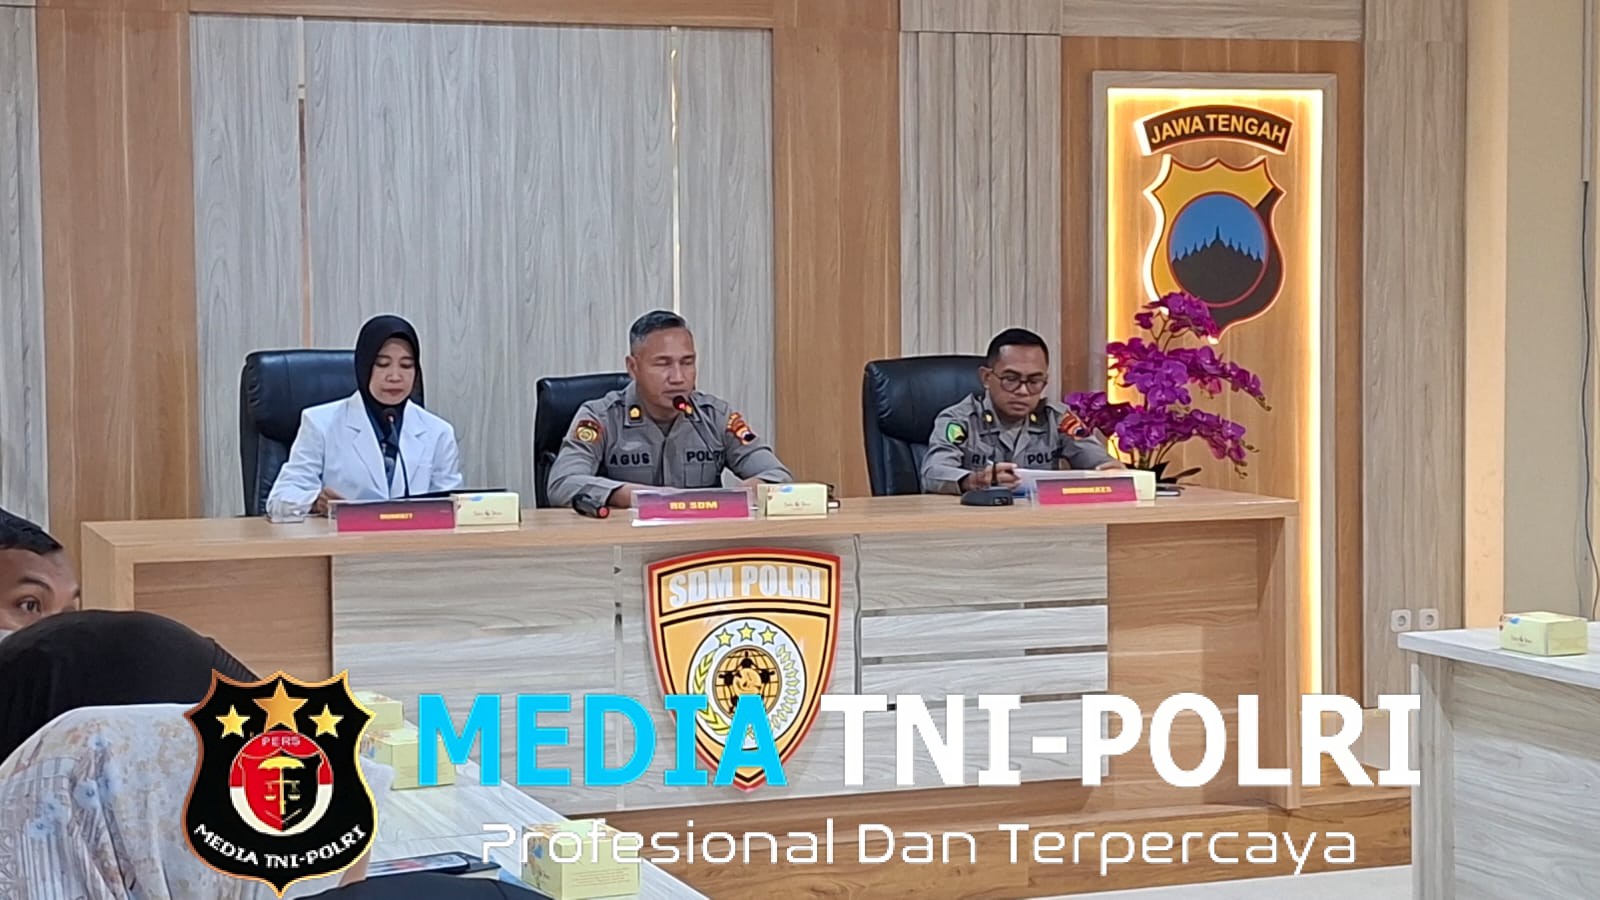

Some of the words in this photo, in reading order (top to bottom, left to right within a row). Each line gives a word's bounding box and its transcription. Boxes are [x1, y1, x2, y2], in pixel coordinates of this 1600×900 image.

[1151, 116, 1205, 144] JAWA
[1205, 114, 1287, 144] TENGAH
[609, 452, 650, 465] AGUS
[689, 500, 718, 510] SDM
[668, 566, 733, 608] SDM
[740, 564, 822, 601] POLRI
